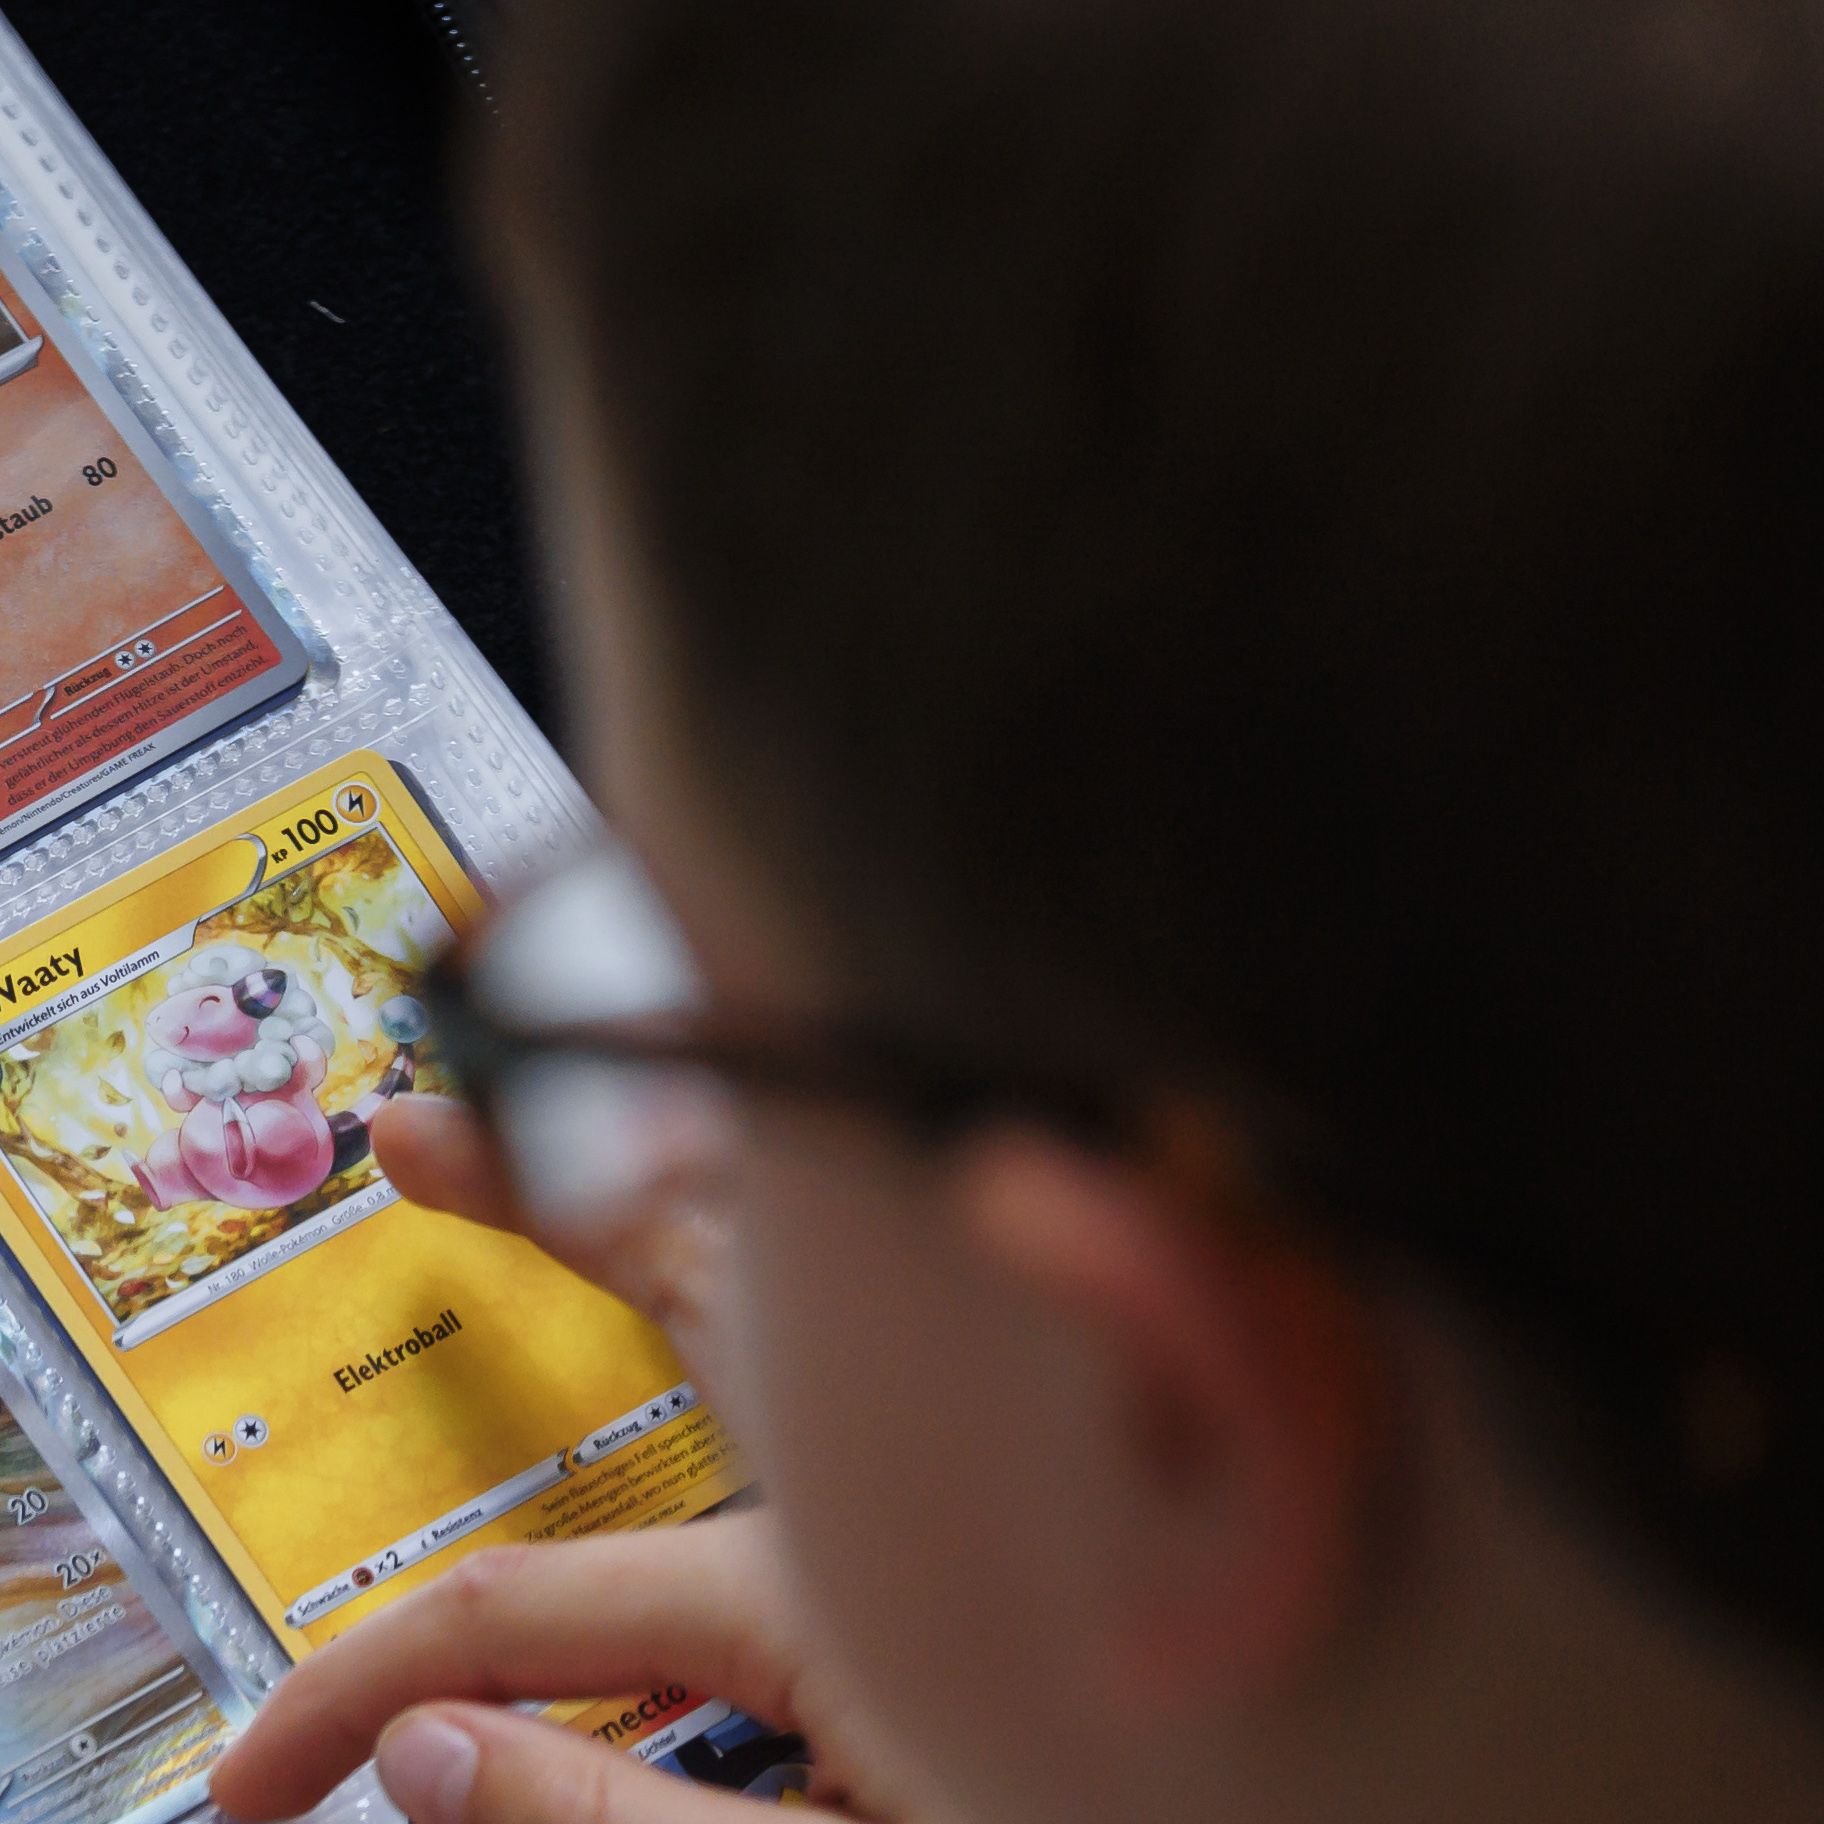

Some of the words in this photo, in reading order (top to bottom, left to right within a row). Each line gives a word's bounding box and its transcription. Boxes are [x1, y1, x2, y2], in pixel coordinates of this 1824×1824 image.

[81, 455, 118, 487] 80
[280, 808, 339, 852] 100
[55, 992, 80, 1013] sich
[79, 981, 101, 1000] aus
[98, 949, 160, 987] Voltilamm
[332, 1309, 462, 1393] Elektroball
[9, 1489, 46, 1523] 20
[591, 1686, 686, 1744] necto
